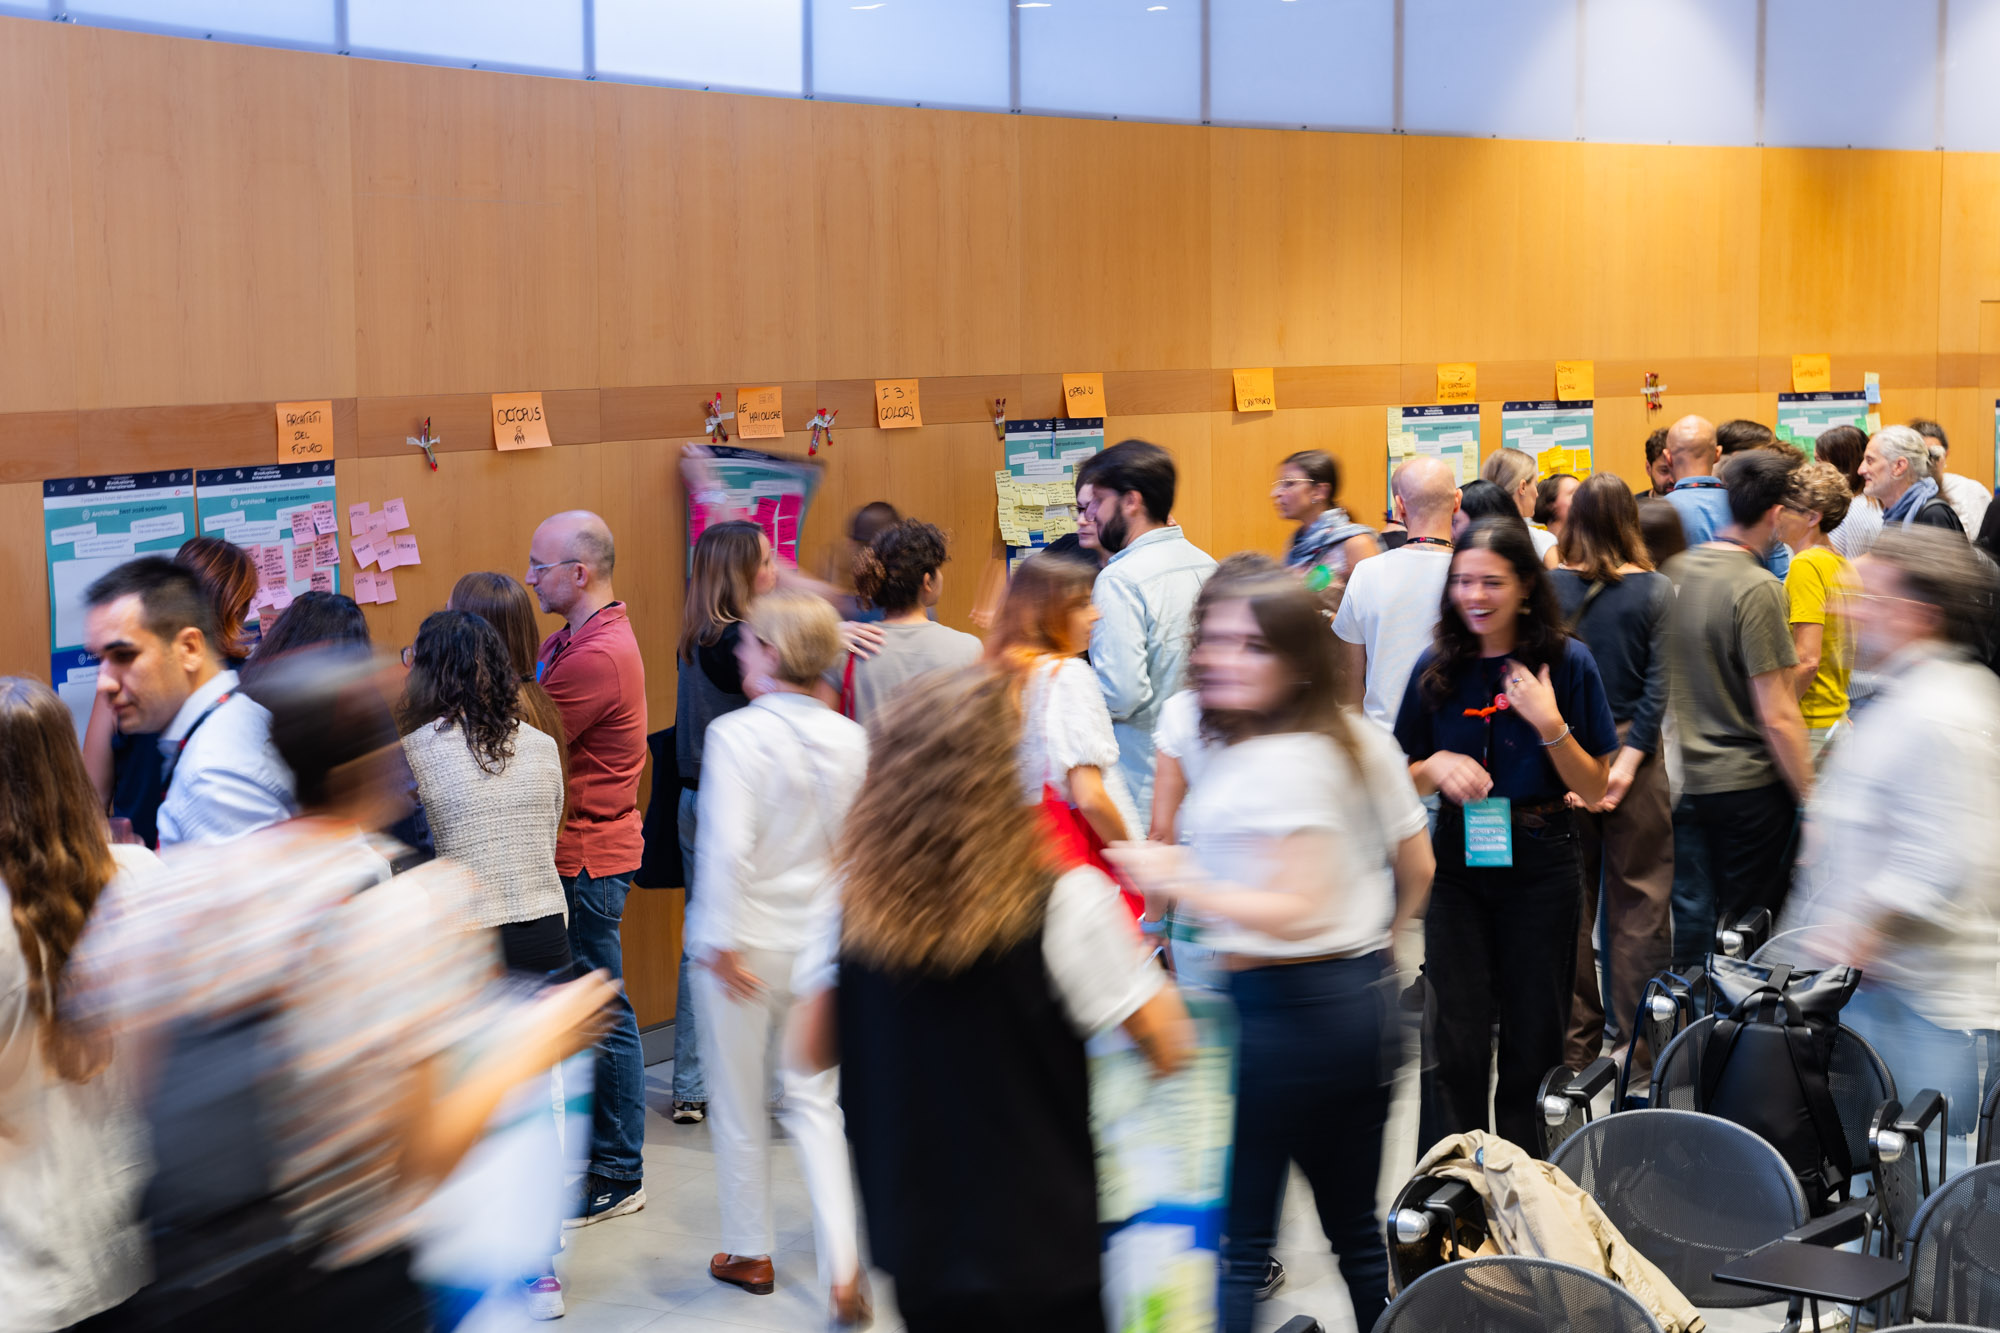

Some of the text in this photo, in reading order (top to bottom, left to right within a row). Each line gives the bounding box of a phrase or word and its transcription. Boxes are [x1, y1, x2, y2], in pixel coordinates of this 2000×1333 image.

[893, 386, 905, 399] 3
[1068, 386, 1086, 398] OPEN
[738, 403, 748, 413] LE
[497, 406, 542, 425] OCTOPUS
[294, 430, 310, 441] DEL
[291, 443, 323, 455] FUTURO
[593, 1192, 613, 1207] S
